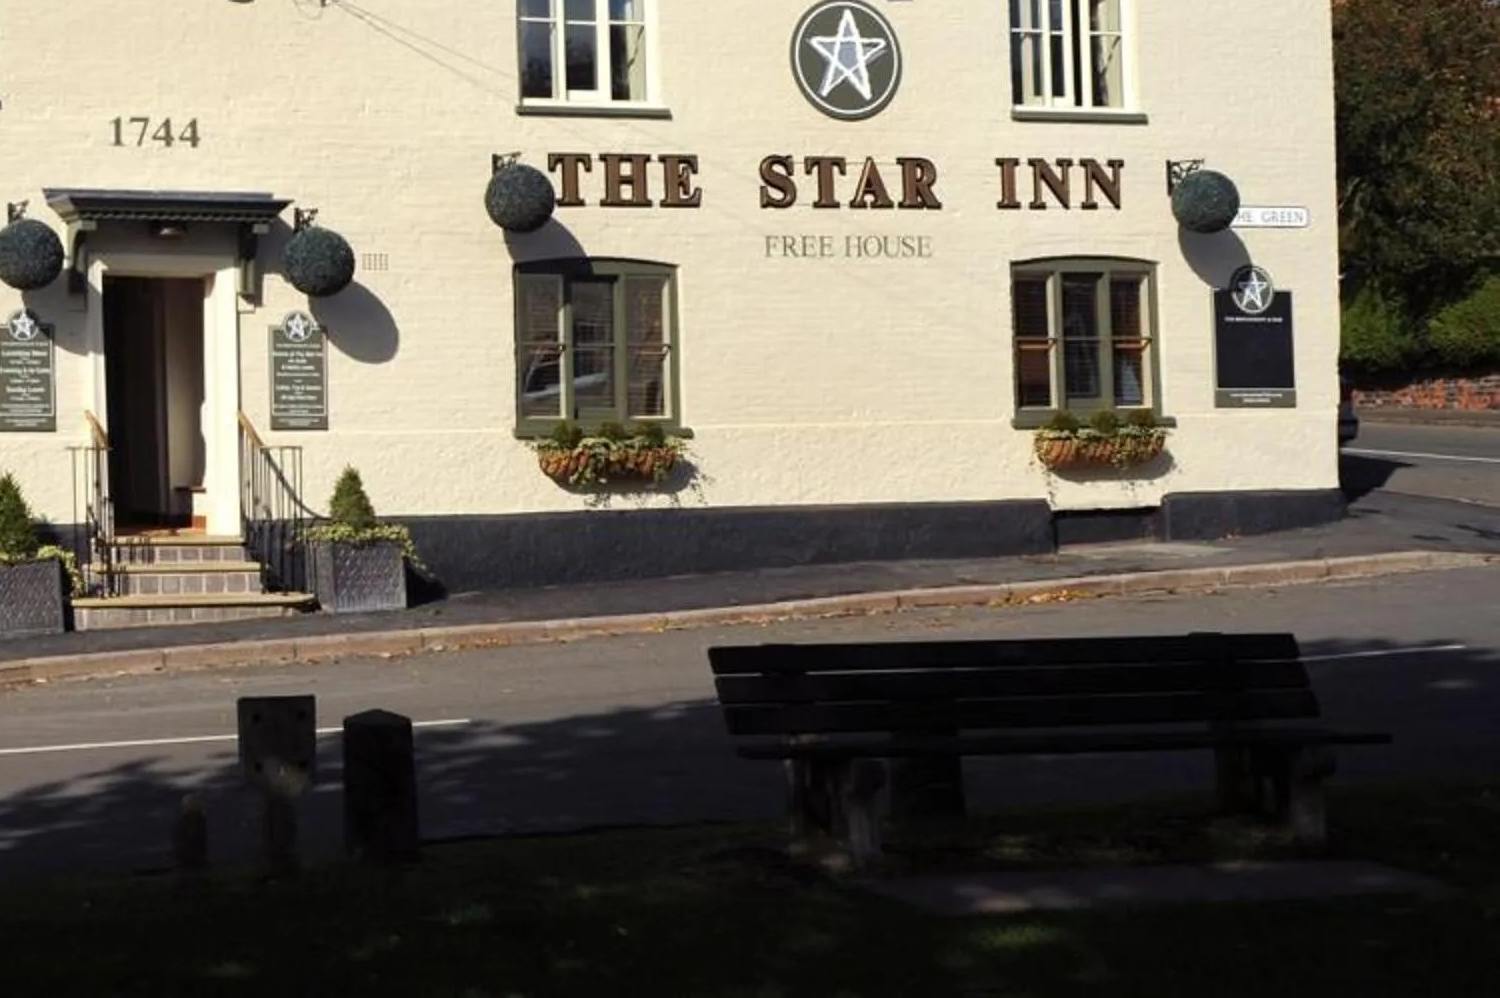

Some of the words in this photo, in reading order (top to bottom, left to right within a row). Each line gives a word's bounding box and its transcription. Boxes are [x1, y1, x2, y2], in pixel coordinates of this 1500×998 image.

[108, 116, 201, 148] 1744
[547, 152, 703, 208] THE
[758, 154, 943, 210] STAR
[995, 157, 1125, 210] INN
[1261, 210, 1304, 223] GREEN
[764, 235, 835, 258] FREE
[844, 234, 934, 258] HOUSE
